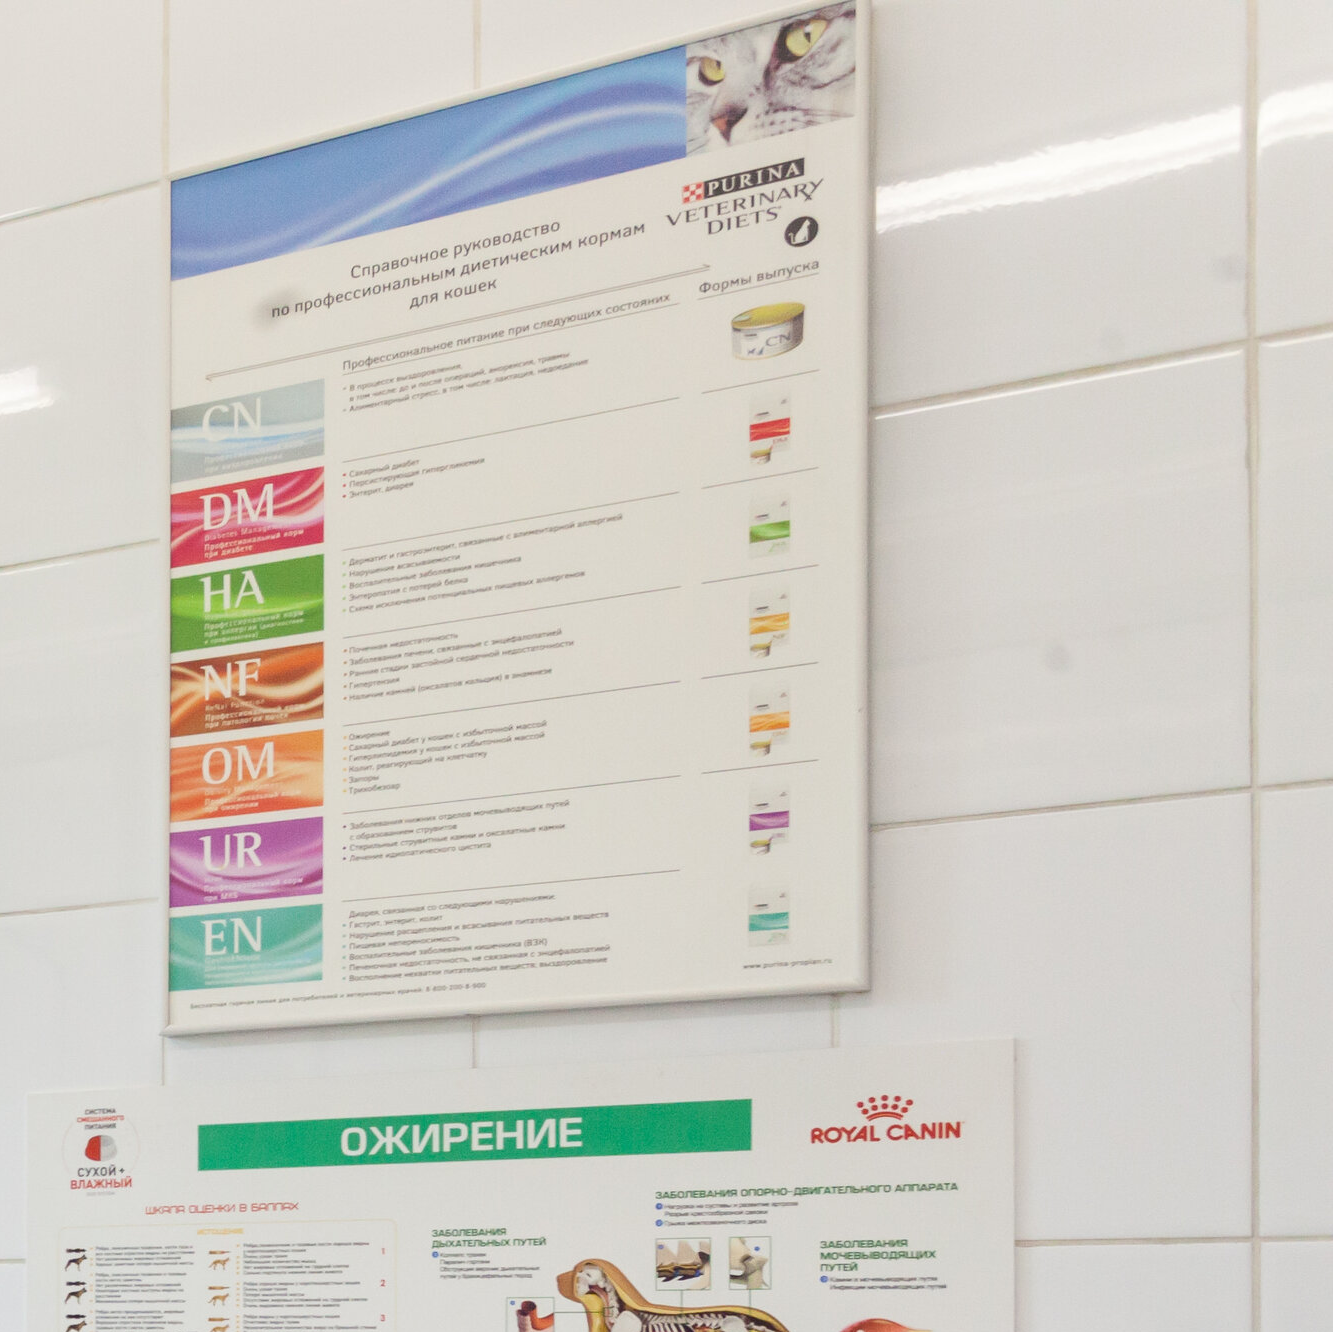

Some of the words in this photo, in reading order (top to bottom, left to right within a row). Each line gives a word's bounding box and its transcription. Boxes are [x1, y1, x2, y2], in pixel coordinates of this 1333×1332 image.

[707, 162, 801, 196] PURINA
[666, 178, 823, 227] VETERINARY
[707, 209, 779, 236] DIETS
[351, 247, 448, 278] Справочное
[453, 221, 560, 259] руководство
[271, 304, 289, 318] по
[294, 267, 455, 314] профессиональным
[459, 240, 571, 276] диетическим
[578, 223, 644, 247] кормам
[699, 274, 751, 298] Формы
[757, 260, 820, 284] выпуска
[409, 292, 438, 309] для
[443, 279, 496, 299] кошек
[342, 340, 453, 370] Профессиональное
[456, 329, 504, 346] питание
[507, 324, 529, 336] при
[533, 308, 601, 330] следующих
[202, 396, 262, 442] CN
[199, 483, 274, 530] DM
[199, 570, 264, 612] HA
[200, 657, 261, 701] NF
[202, 741, 274, 785] OM
[199, 831, 262, 871] UR
[201, 916, 261, 956] EN
[340, 1117, 583, 1157] ОЖИРЕНИЕ
[811, 1126, 880, 1144] ROYAL
[886, 1121, 961, 1141] CANIN
[70, 1176, 132, 1189] ВЛАЖНЫЙ
[77, 1164, 116, 1177] СУХОЙ
[189, 1204, 235, 1213] ОЦЕНКИ
[239, 1203, 247, 1212] В
[655, 1189, 737, 1199] ЗАБОЛЕВАНИЯ
[740, 1184, 891, 1196] ОПОРНО-ДВИГАТЕЛЬНОГО
[894, 1182, 957, 1191] АППАРАТА
[431, 1239, 509, 1248] ДЫХАТЕЛЬНЫХ
[513, 1237, 545, 1246] ПУТЕЙ
[432, 1228, 507, 1238] ЗАБОЛЕВАНИЯ
[821, 1239, 907, 1248] ЗАБОЛЕВАНИЯ
[820, 1250, 935, 1262] МОЧЕВЫВОДЯЩИХ
[820, 1261, 857, 1271] ПУТЕЙ
